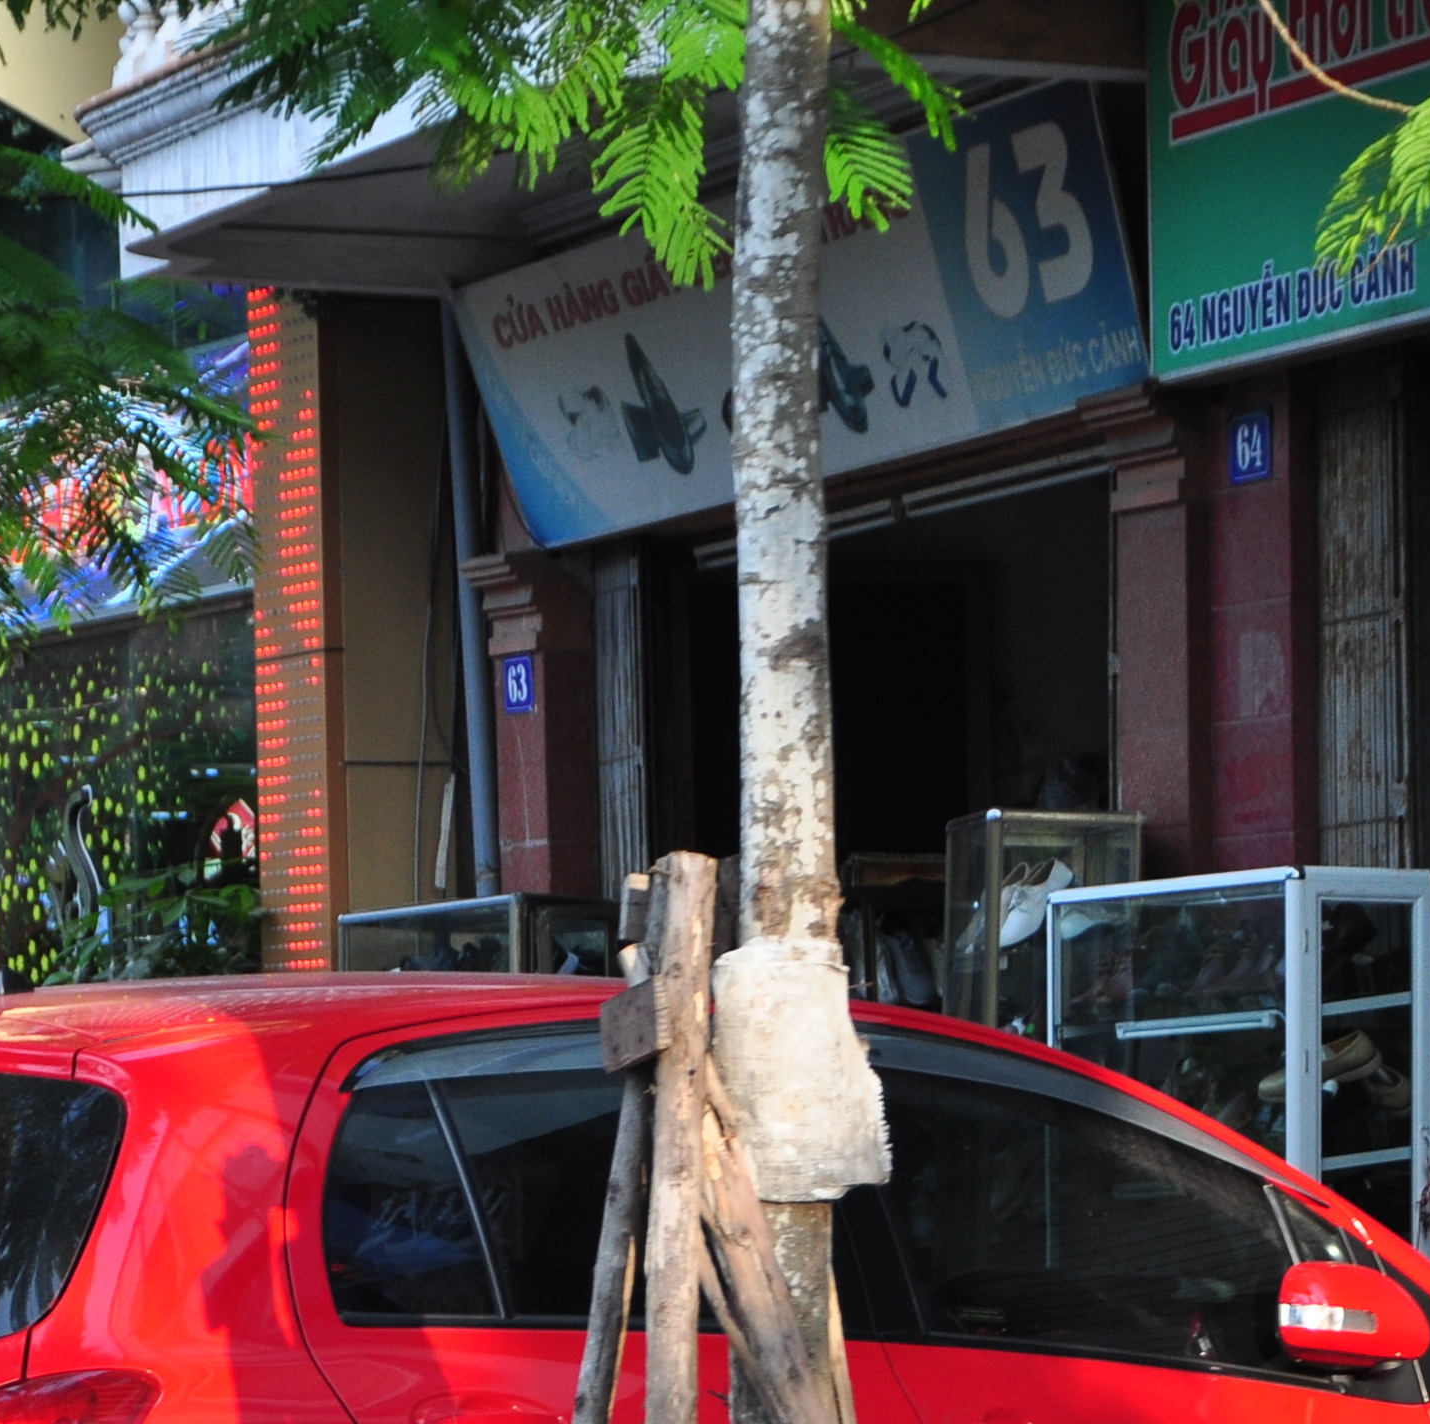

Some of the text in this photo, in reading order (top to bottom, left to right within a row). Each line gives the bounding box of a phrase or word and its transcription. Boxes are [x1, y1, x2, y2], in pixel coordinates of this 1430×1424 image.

[965, 121, 1094, 320] 63
[545, 280, 620, 332] HÀNG
[1170, 302, 1196, 351] 64
[1236, 422, 1263, 471] 64
[508, 663, 528, 703] 63
